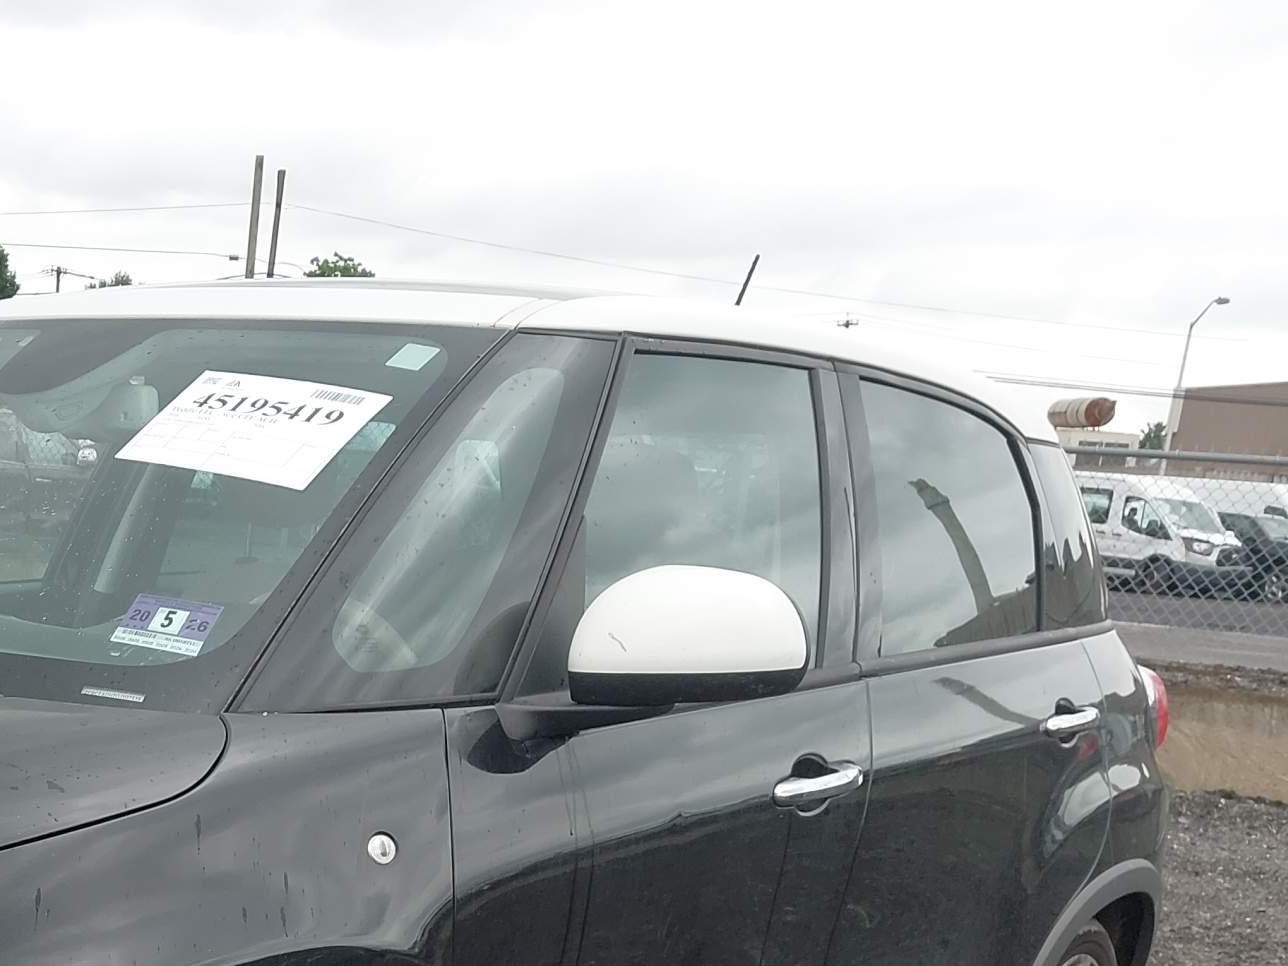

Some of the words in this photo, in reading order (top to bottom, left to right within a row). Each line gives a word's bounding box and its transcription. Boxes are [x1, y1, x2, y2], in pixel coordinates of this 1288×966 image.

[193, 392, 345, 426] 45195419
[129, 608, 152, 622] 20
[160, 610, 178, 628] 5
